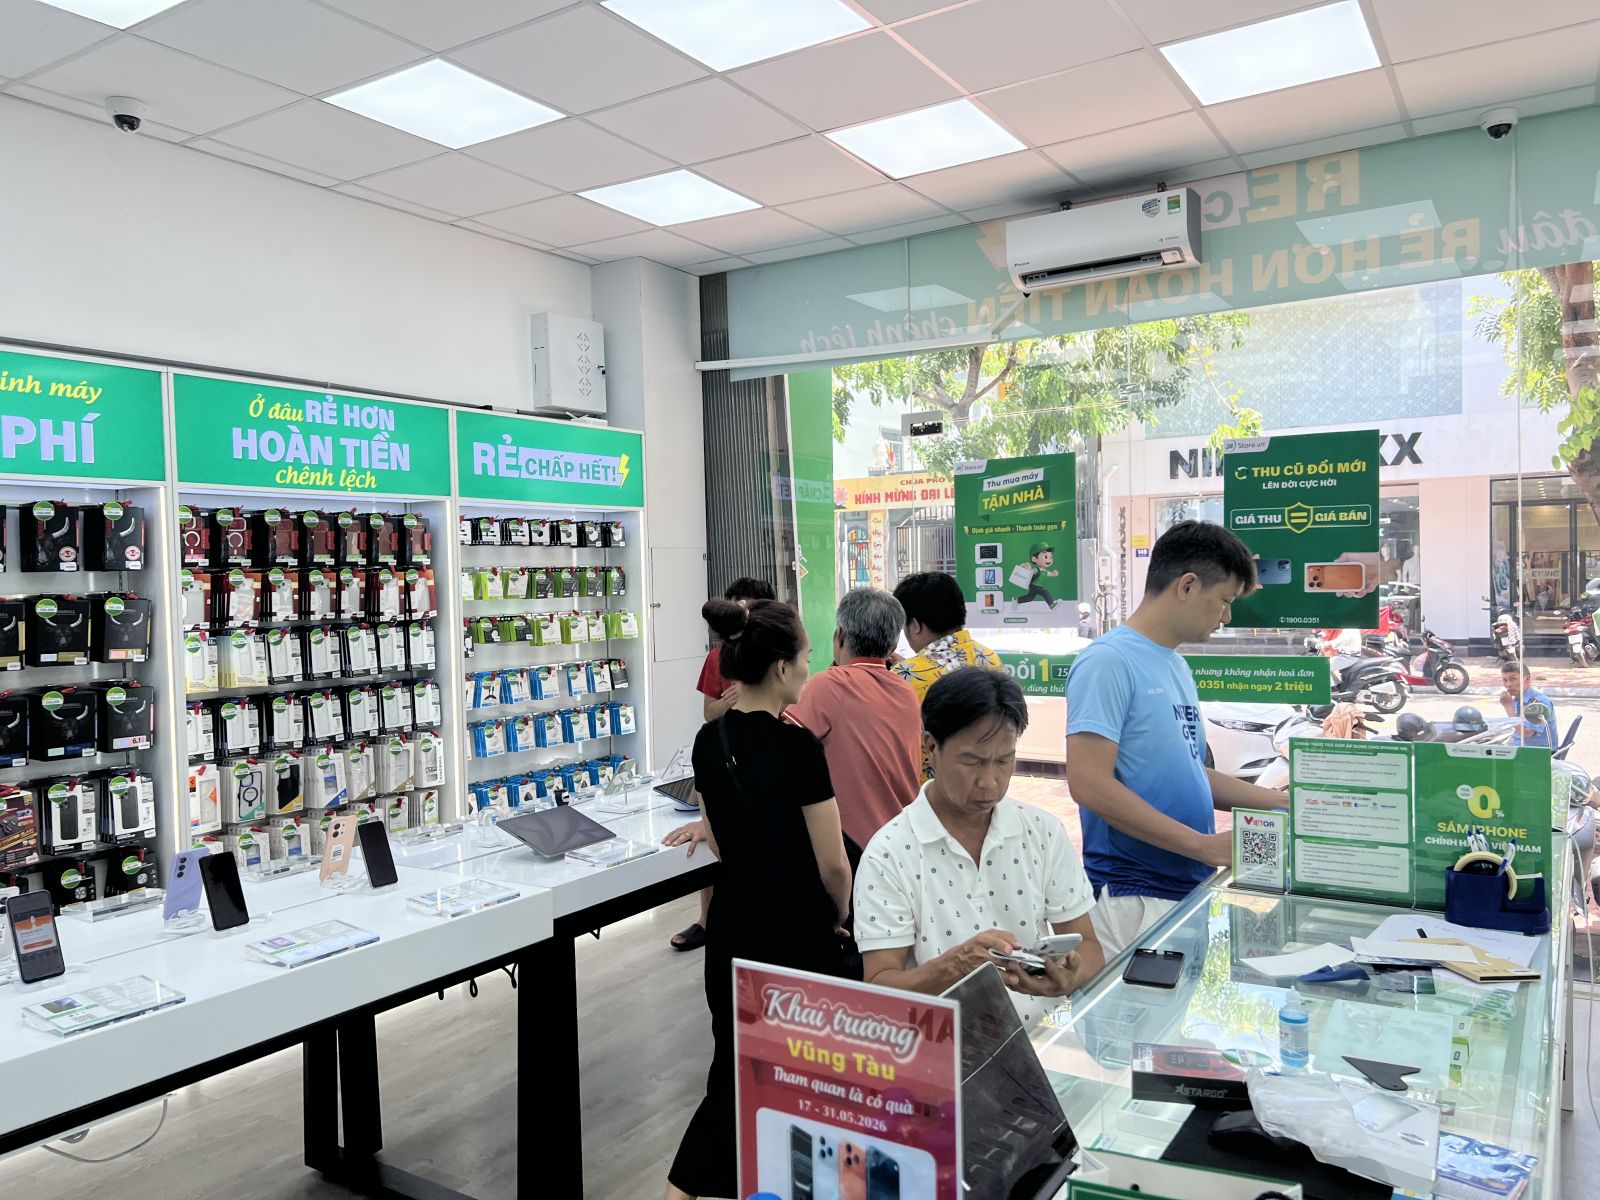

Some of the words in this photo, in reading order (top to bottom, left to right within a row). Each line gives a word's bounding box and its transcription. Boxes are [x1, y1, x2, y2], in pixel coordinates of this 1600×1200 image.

[0, 371, 42, 394] inh
[49, 381, 103, 404] máy
[249, 393, 266, 418] Ở
[268, 403, 304, 421] đâu
[305, 395, 338, 425] RẺ
[343, 403, 395, 431] HƠN
[1, 413, 101, 464] PHÍ
[232, 425, 333, 466] HOÀN
[340, 431, 411, 471] TIỀN
[473, 434, 521, 478] RẺ
[525, 454, 575, 479] CHẤP
[579, 459, 616, 482] HẾT!
[1252, 466, 1280, 477] THU
[1283, 463, 1304, 476] CŨ
[1307, 459, 1333, 475] ĐỔI
[1337, 459, 1366, 473] MỚI
[275, 466, 334, 487] chênh
[339, 469, 377, 492] lệch
[987, 480, 1001, 488] Thu
[1021, 472, 1039, 481] máy
[1262, 480, 1280, 489] LÊN
[1281, 479, 1298, 489] ĐỜI
[1299, 479, 1319, 490] CỰC
[1320, 478, 1337, 487] HỜI
[982, 493, 1010, 512] TẬN
[1012, 484, 1045, 505] NHÀ
[1235, 513, 1256, 524] GIÁ
[1257, 514, 1282, 524] THU
[1315, 511, 1337, 522] GIÁ
[1339, 510, 1366, 521] BÁN
[1286, 616, 1320, 624] 1900.0351
[1039, 658, 1049, 681] 1
[1195, 668, 1222, 677] nhưng
[1224, 667, 1251, 678] không
[1253, 668, 1276, 679] nhận
[1278, 668, 1296, 677] hoá
[1297, 669, 1315, 678] đơn
[1027, 684, 1048, 694] dùng
[1197, 680, 1225, 689] .0351
[1227, 683, 1249, 692] nhận
[1250, 684, 1273, 692] ngay
[1274, 682, 1282, 691] 2
[1284, 681, 1313, 693] triệu
[1472, 825, 1527, 839] IPHONE
[1424, 836, 1457, 846] CHÍNH
[1516, 844, 1542, 853] NAM
[766, 988, 827, 1027] Khai
[833, 1007, 917, 1054] trương
[787, 1037, 846, 1073] Vũng
[852, 1051, 895, 1081] Tàu
[773, 1065, 808, 1088] Tham
[811, 1077, 845, 1098] quan
[849, 1087, 864, 1103] là
[866, 1093, 882, 1109] có
[885, 1099, 914, 1116] quà
[1183, 1086, 1225, 1099] STARGO
[798, 1099, 811, 1112] 17
[822, 1105, 888, 1133] 31.05.2026
